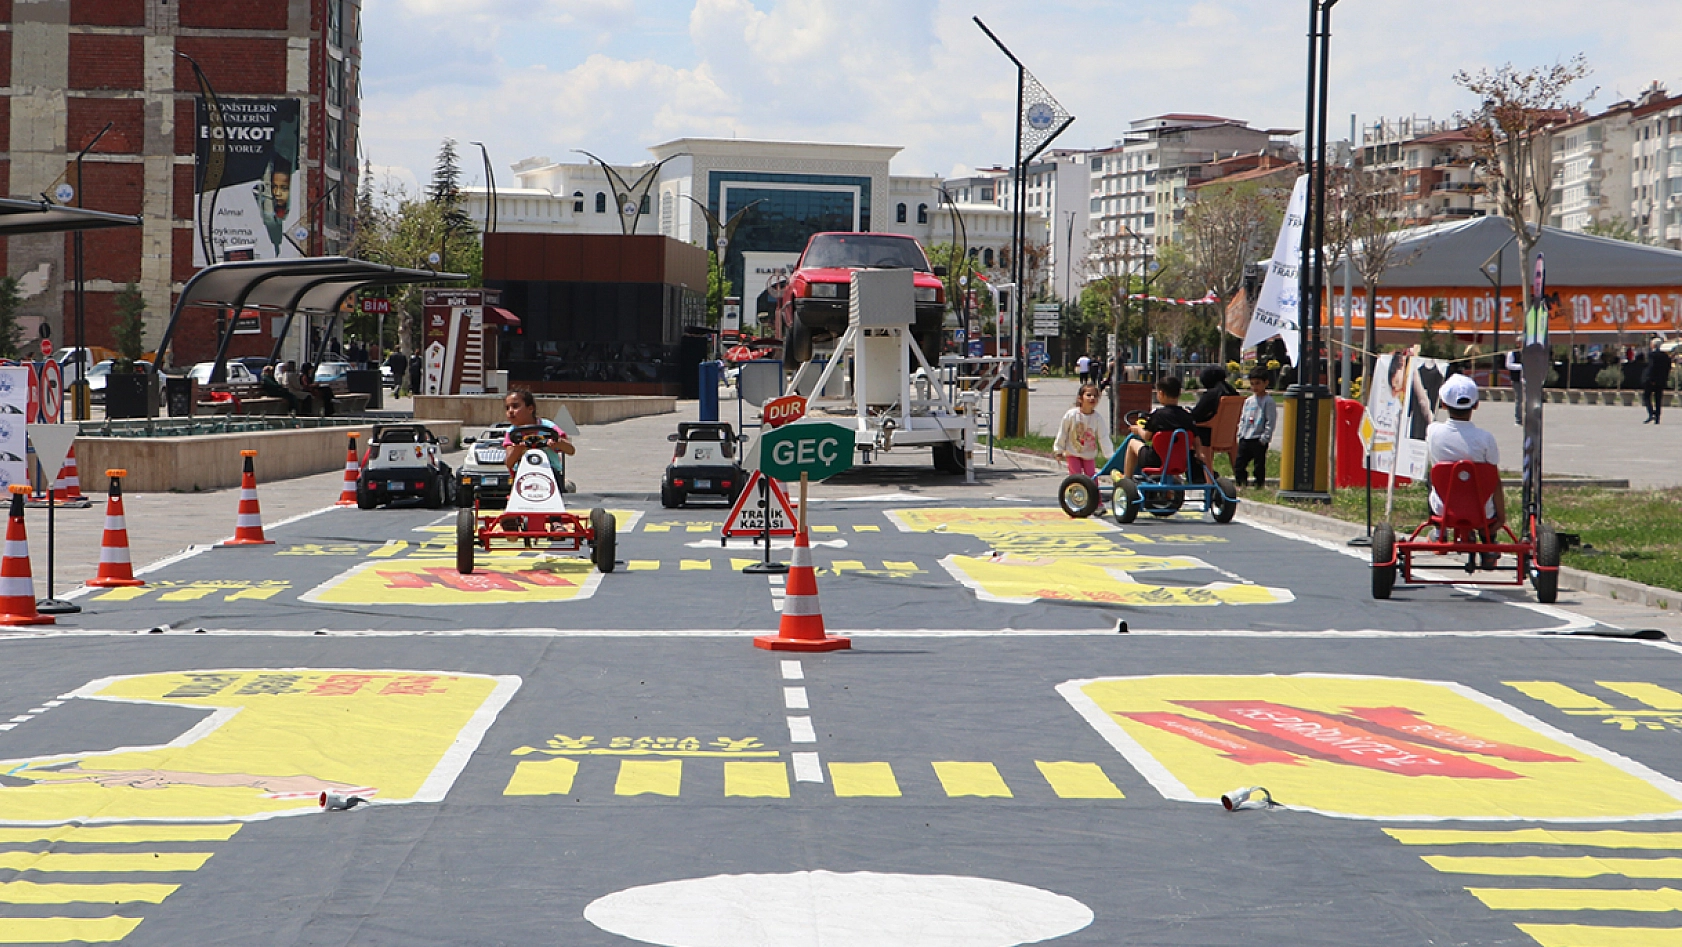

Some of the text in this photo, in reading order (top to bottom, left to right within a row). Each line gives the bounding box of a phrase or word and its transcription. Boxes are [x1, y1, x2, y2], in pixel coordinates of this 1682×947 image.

[364, 298, 388, 312] BİM
[769, 401, 802, 419] DUR
[772, 437, 839, 466] GEÇ
